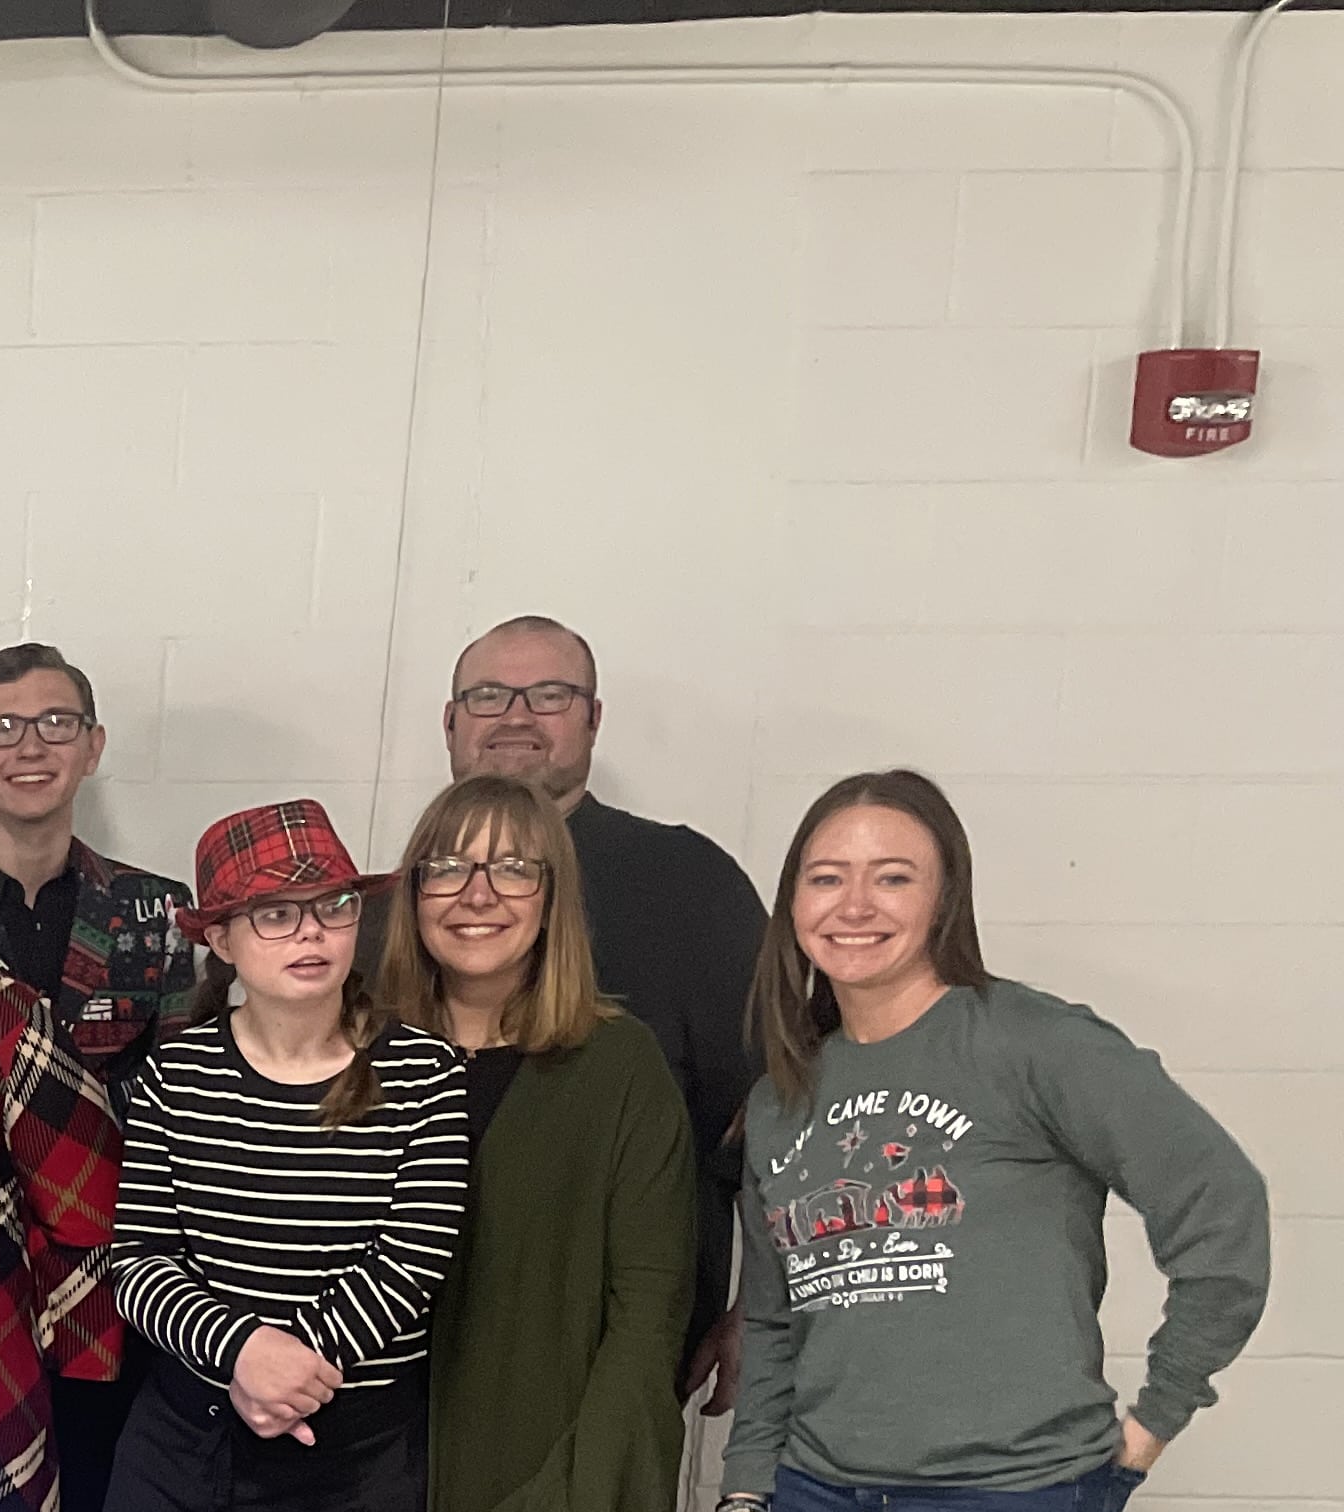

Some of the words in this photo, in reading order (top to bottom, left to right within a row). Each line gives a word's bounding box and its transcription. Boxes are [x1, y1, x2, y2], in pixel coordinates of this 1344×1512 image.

[1185, 427, 1230, 441] FIRE
[826, 1089, 890, 1125] CAME
[897, 1090, 974, 1140] DOWN
[881, 1266, 895, 1282] IS
[899, 1262, 945, 1282] BORN
